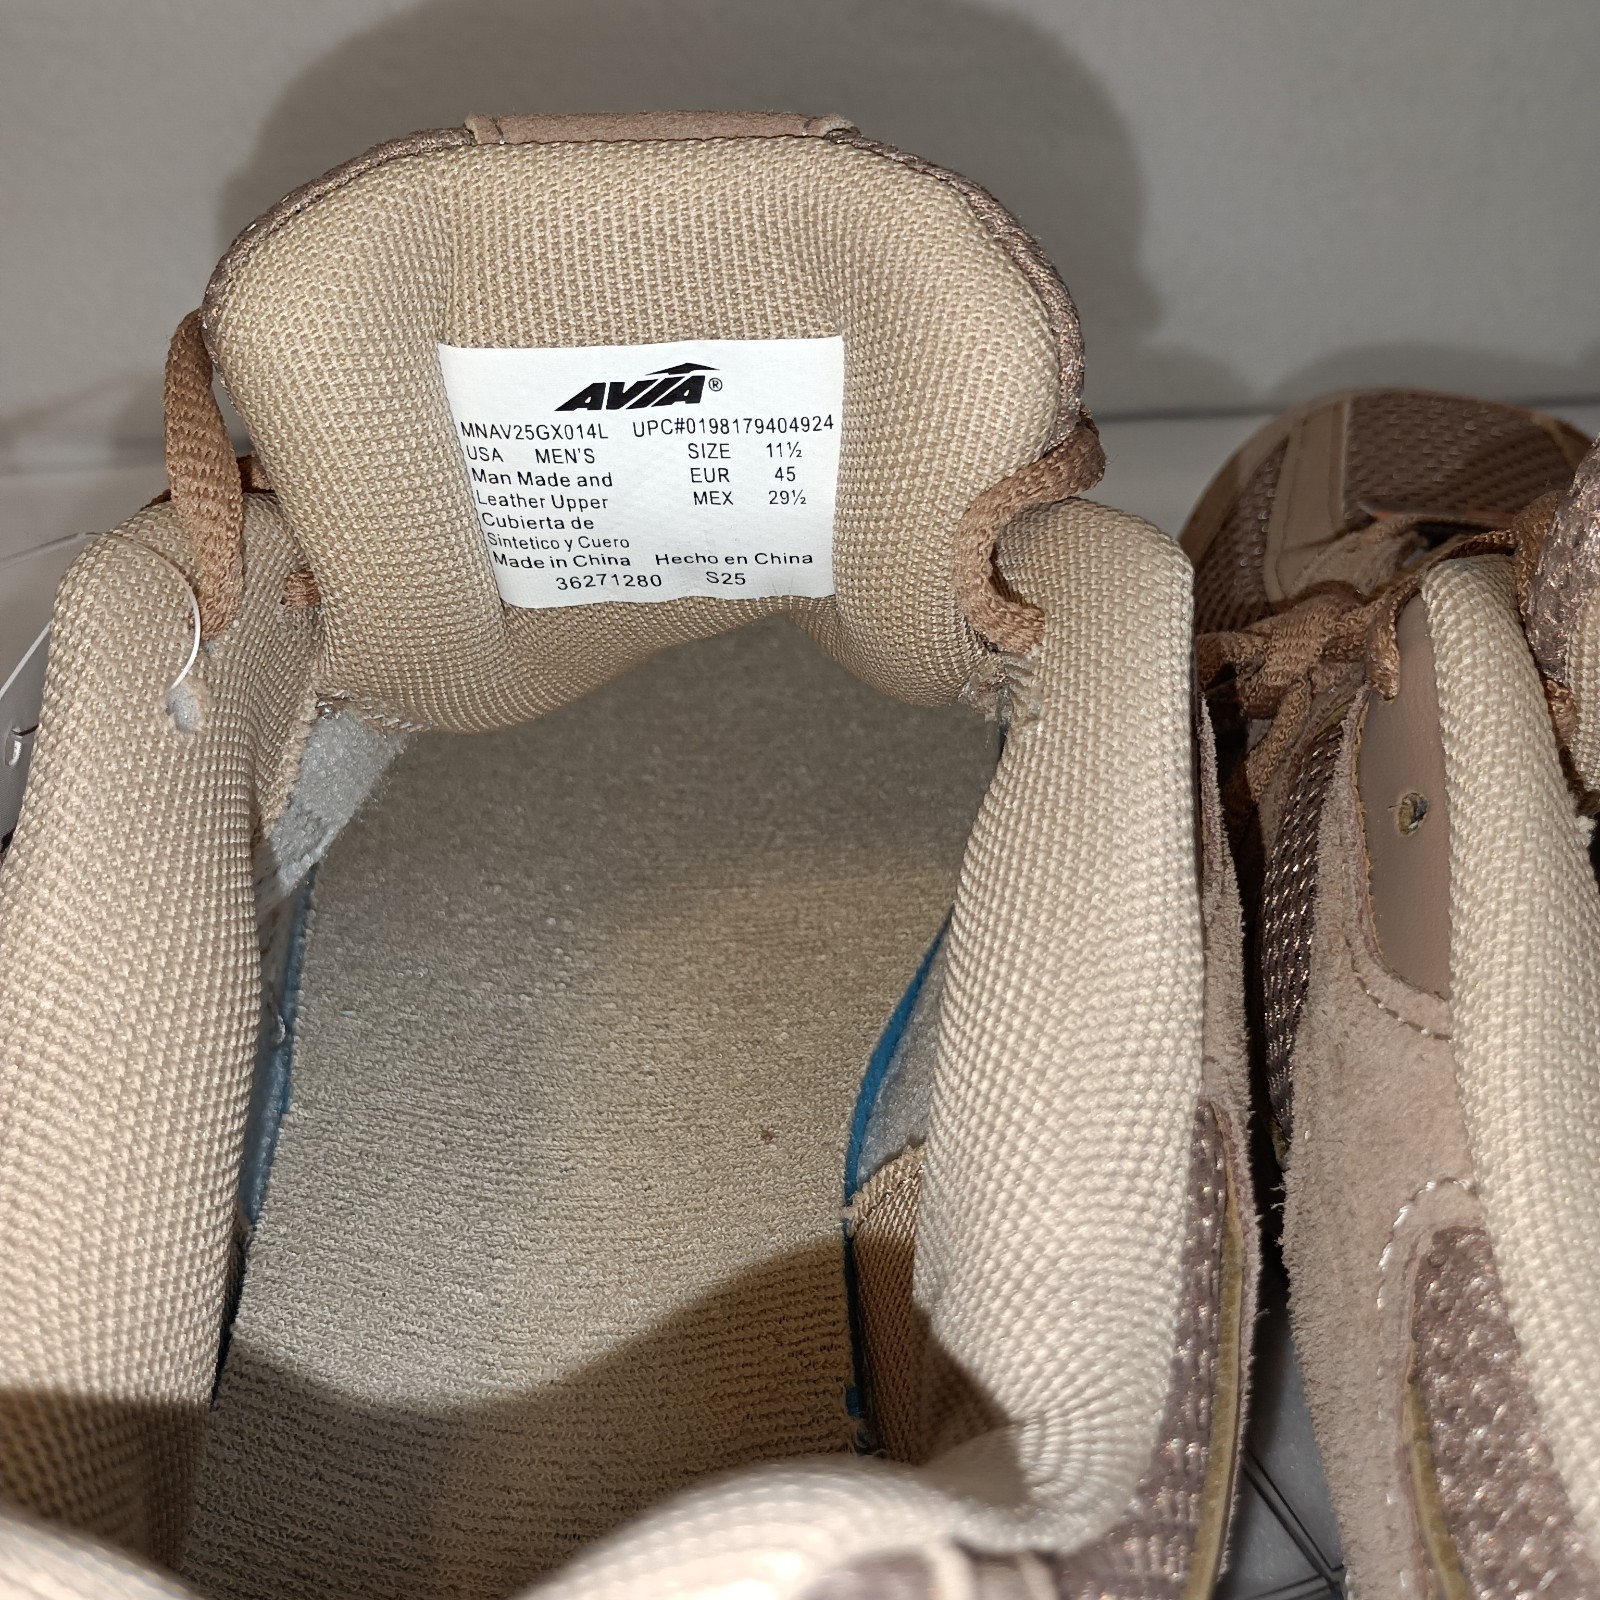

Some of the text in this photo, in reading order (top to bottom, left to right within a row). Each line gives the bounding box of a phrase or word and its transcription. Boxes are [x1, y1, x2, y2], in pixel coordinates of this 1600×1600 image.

[461, 421, 608, 441] MNAV25GX014L
[632, 414, 834, 438] UPC#0198179404924
[466, 445, 596, 464] USA MEN'S
[688, 443, 731, 459] SIZE
[471, 467, 613, 487] Man Made and
[690, 466, 796, 483] EUR 45
[476, 490, 609, 512] Leather Upper
[693, 491, 734, 506] MEX
[481, 512, 595, 530] Cubierta de
[487, 532, 630, 552] Sintetico y Cuero
[492, 551, 631, 569] Made in China
[655, 552, 814, 566] Hecho en China
[556, 573, 663, 590] 36271280
[705, 571, 746, 585] S25
